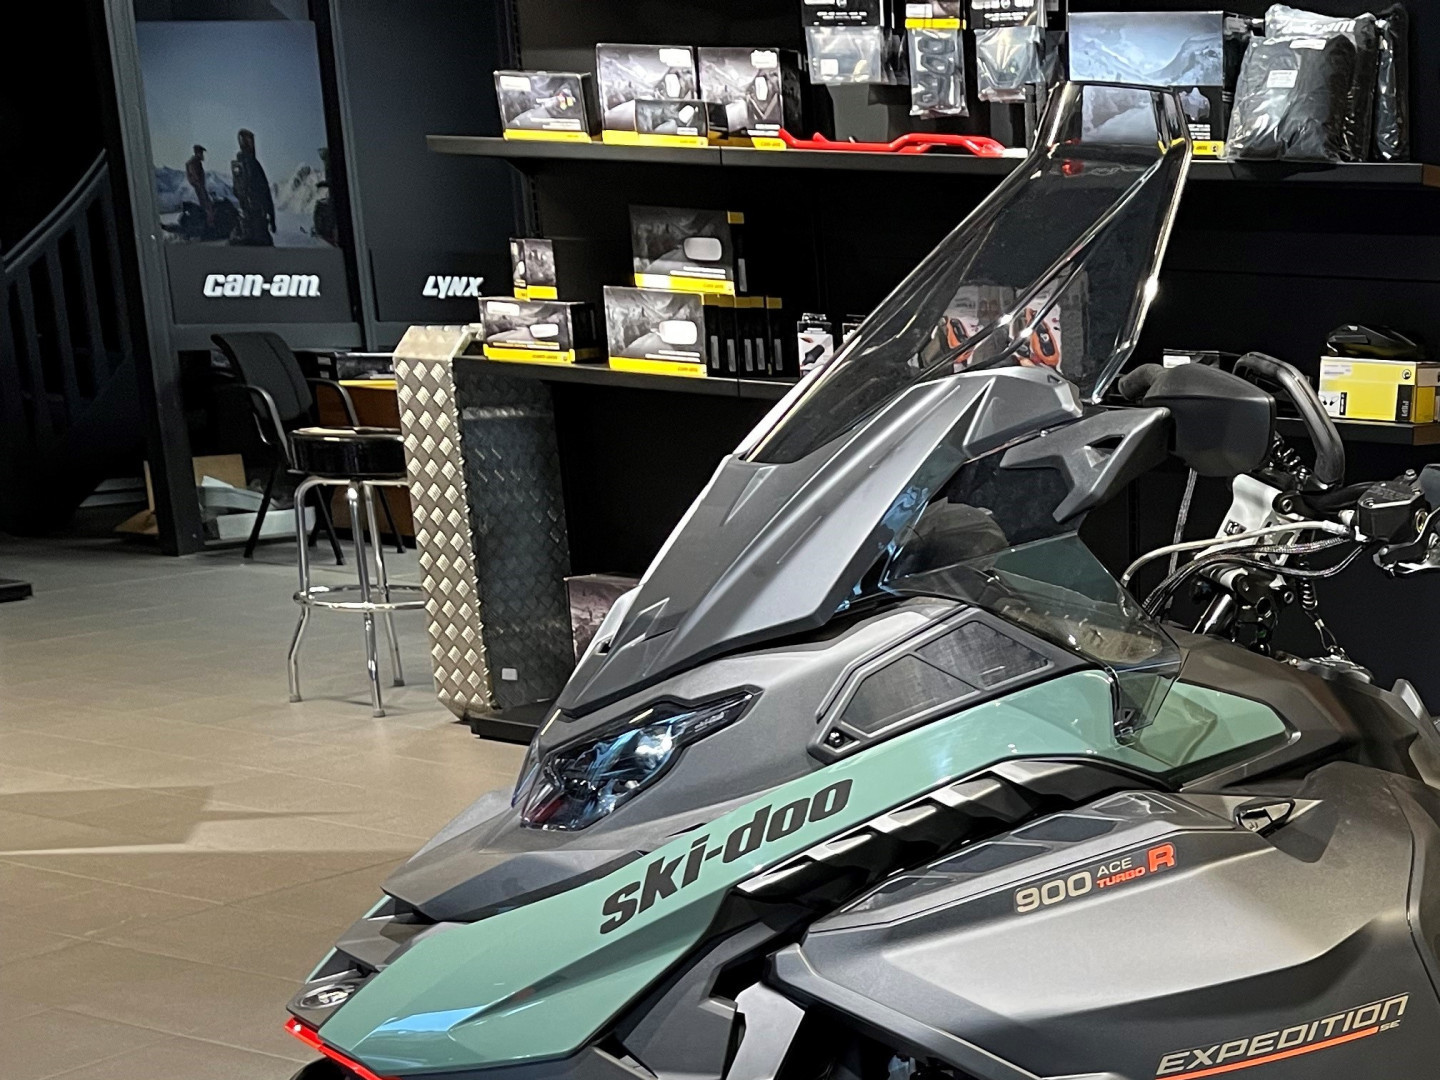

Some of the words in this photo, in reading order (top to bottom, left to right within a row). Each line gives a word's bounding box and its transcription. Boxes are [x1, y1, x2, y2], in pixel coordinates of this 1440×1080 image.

[422, 275, 484, 299] LYNX
[600, 779, 854, 936] ski-doo
[1096, 857, 1133, 878] ACE
[1147, 842, 1176, 873] R
[1015, 871, 1093, 913] 900
[1096, 866, 1147, 889] TURBO
[1156, 995, 1409, 1075] EXPEDITION
